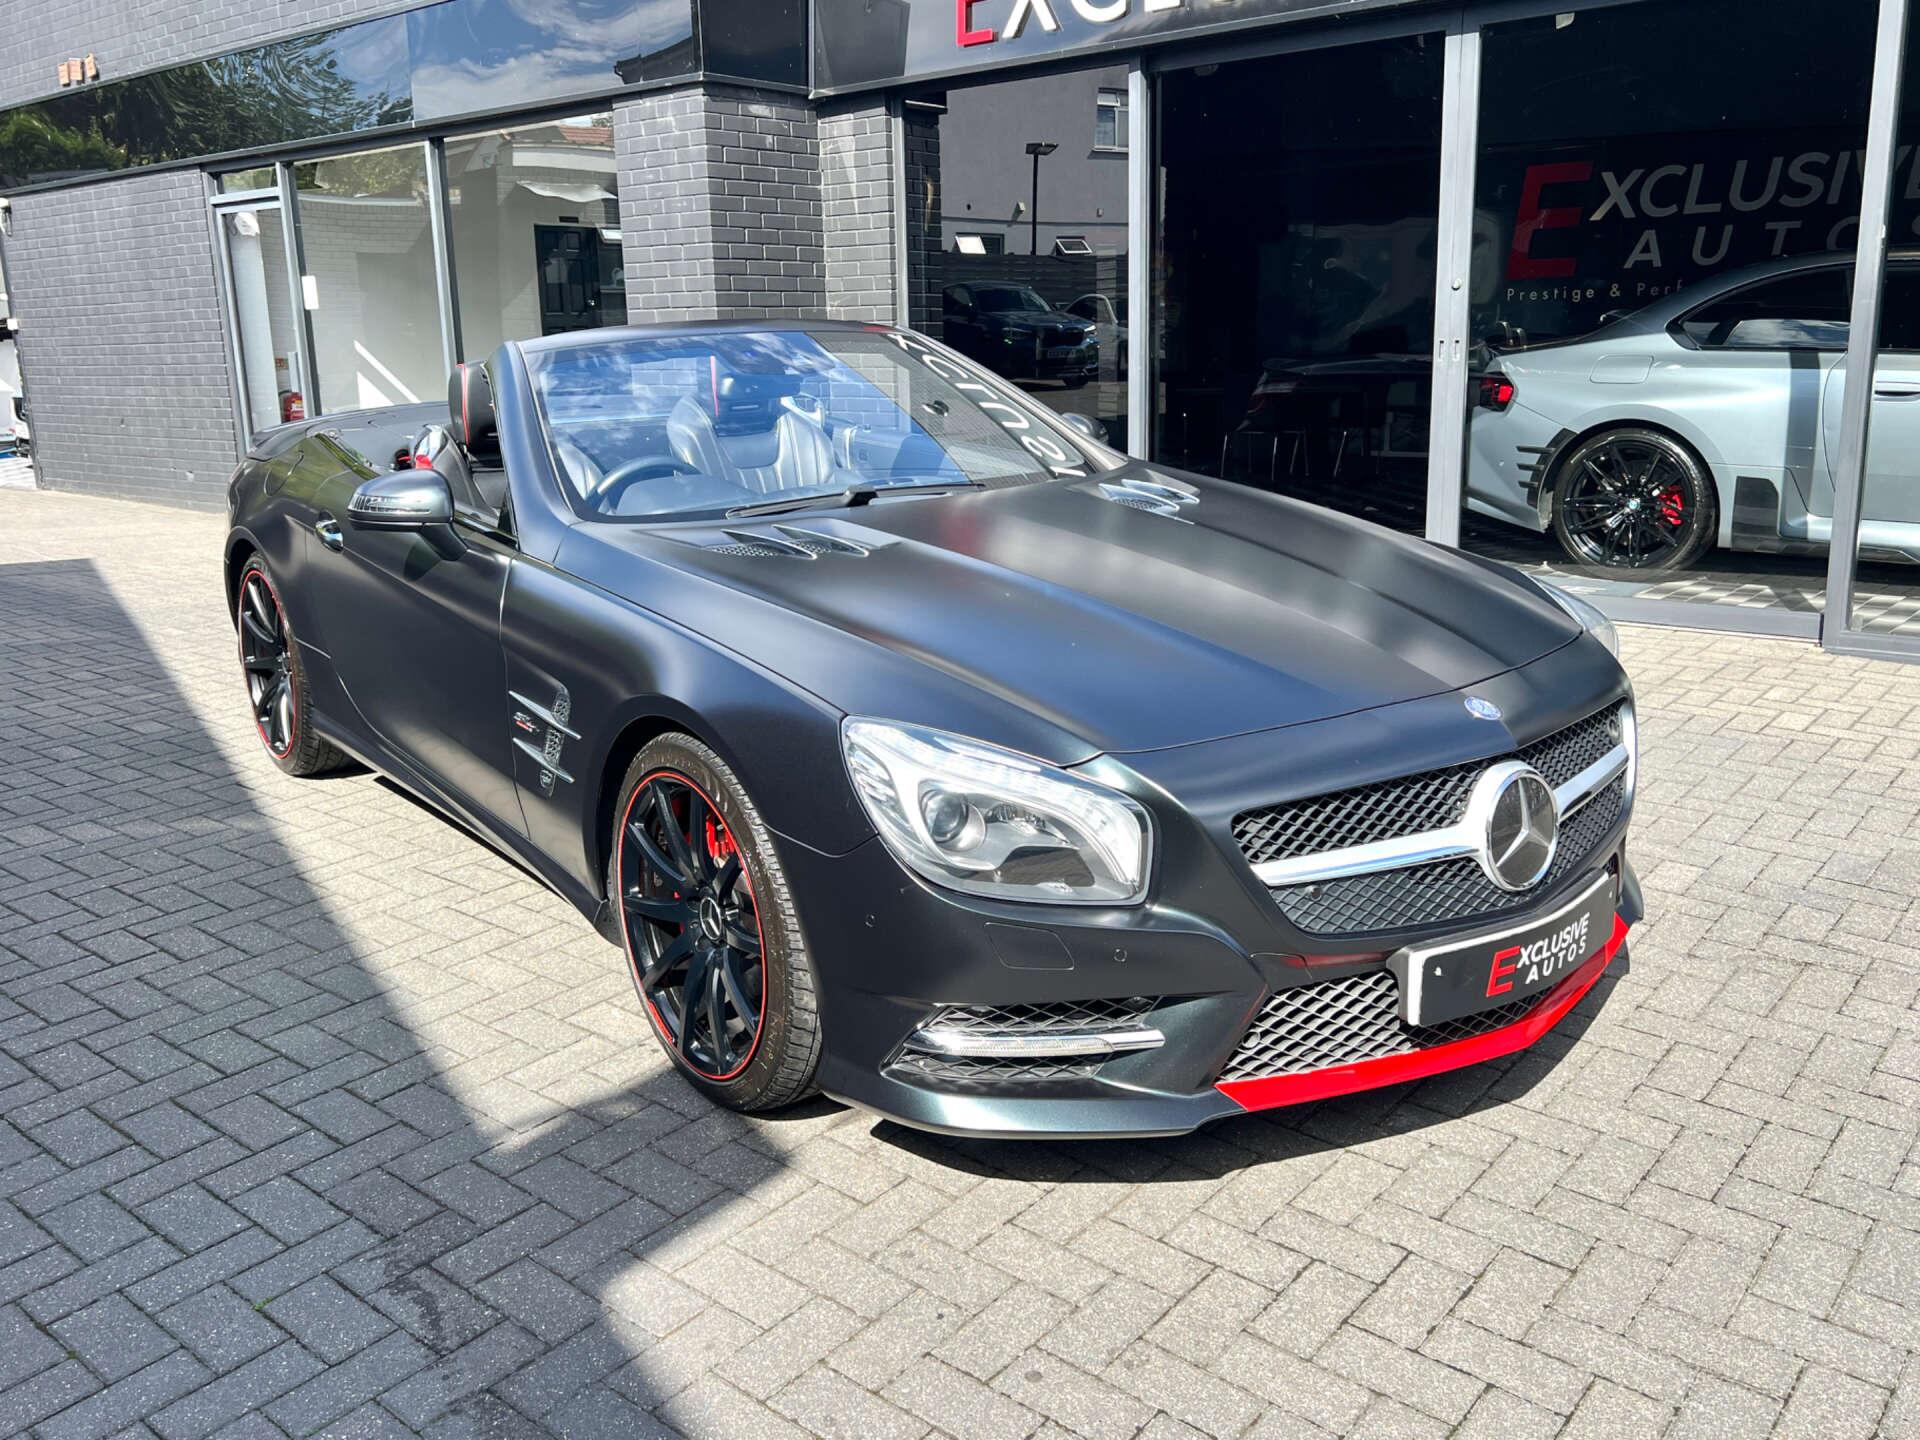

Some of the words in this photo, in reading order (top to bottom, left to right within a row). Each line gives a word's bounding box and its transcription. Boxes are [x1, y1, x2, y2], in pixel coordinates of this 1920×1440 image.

[1507, 286, 1595, 302] Prestige
[1609, 282, 1622, 298] &
[1486, 911, 1590, 998] EXCLUSIVE
[1525, 935, 1587, 985] AUTOS
